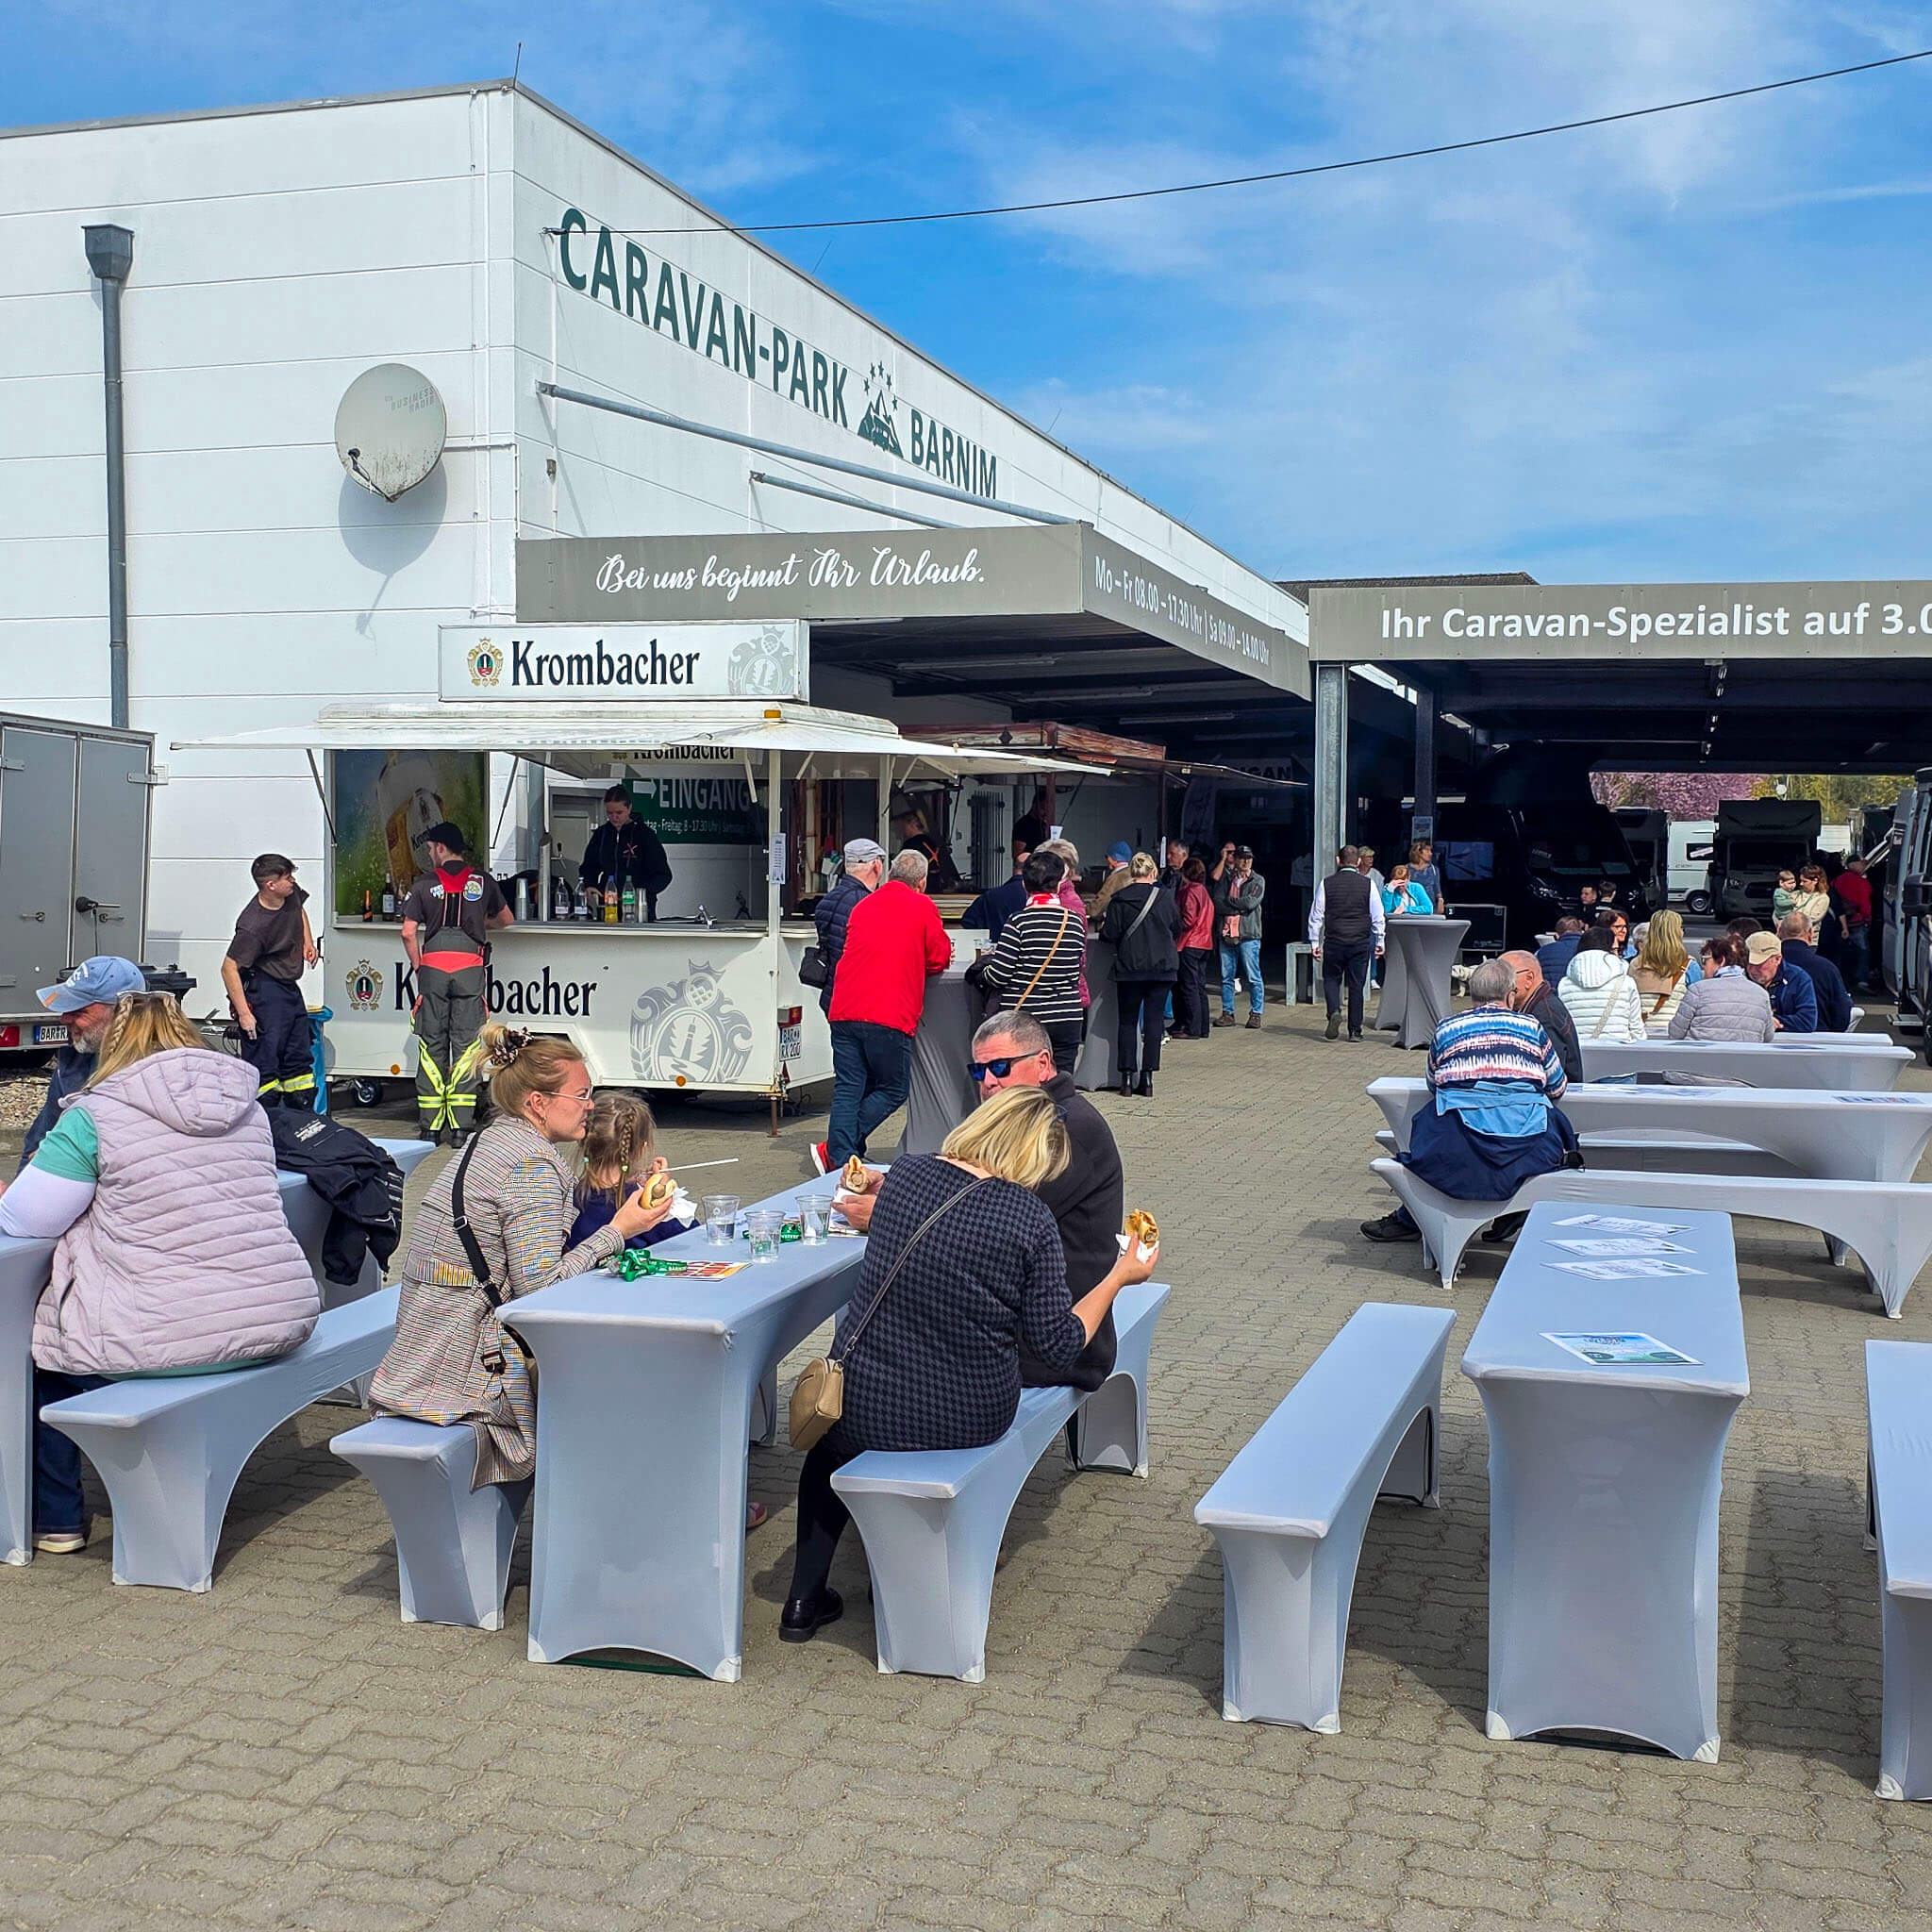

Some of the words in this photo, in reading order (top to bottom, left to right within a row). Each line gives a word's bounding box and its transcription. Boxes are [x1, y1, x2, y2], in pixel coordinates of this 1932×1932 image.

[560, 208, 848, 428] CARAVAN-PARK
[910, 408, 997, 499] BARNIM
[595, 554, 649, 592] Bei
[654, 566, 697, 590] uns
[701, 555, 803, 602] beginnt
[808, 547, 860, 589] Ihr
[869, 547, 986, 587] Urlaub.
[1095, 556, 1112, 594] Mo
[1124, 570, 1133, 602] Fr
[1134, 576, 1159, 615] 08.00
[1168, 592, 1189, 629] 17.30
[1190, 603, 1203, 636] Uhr
[1209, 613, 1218, 642] Sa
[1219, 618, 1236, 650] 09.00
[1241, 630, 1259, 661] 14.00
[1259, 638, 1270, 667] Uhr
[1380, 608, 1431, 639] Ihr
[1441, 603, 1790, 643] Caravan-Spezialist
[1803, 602, 1871, 636] auf
[511, 638, 700, 687] Krombacher
[659, 778, 751, 812] EINGANG
[394, 961, 597, 1017] Kbacher
[41, 1028, 57, 1040] BAR
